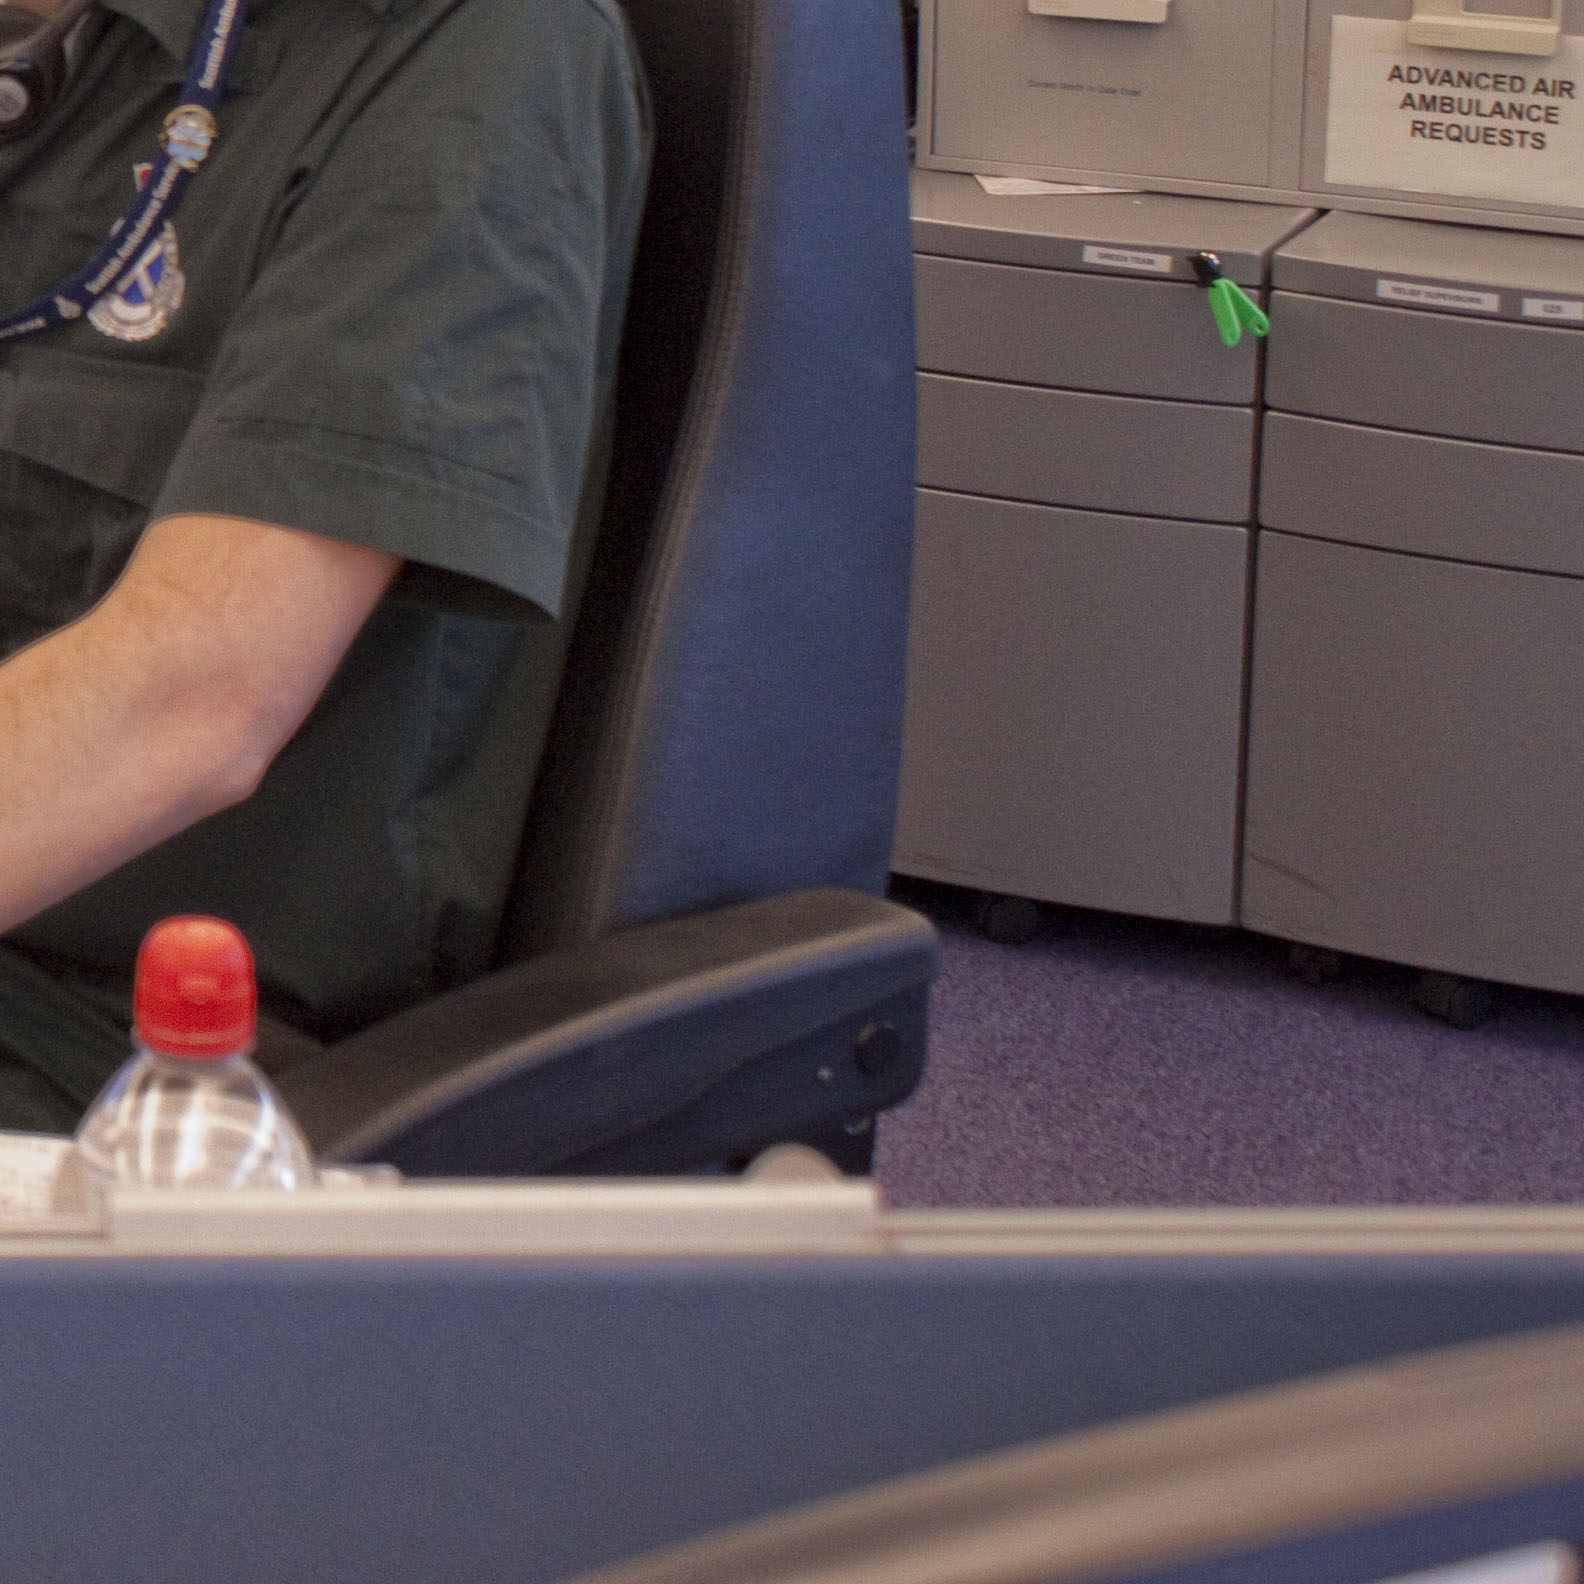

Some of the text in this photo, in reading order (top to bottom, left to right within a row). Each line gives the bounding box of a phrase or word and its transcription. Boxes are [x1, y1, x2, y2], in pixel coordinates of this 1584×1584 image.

[1387, 64, 1575, 100] ADVANCED AIR
[1399, 92, 1560, 125] AMBULANCE
[1410, 119, 1546, 150] REQUESTS
[117, 198, 163, 258] Ambulance
